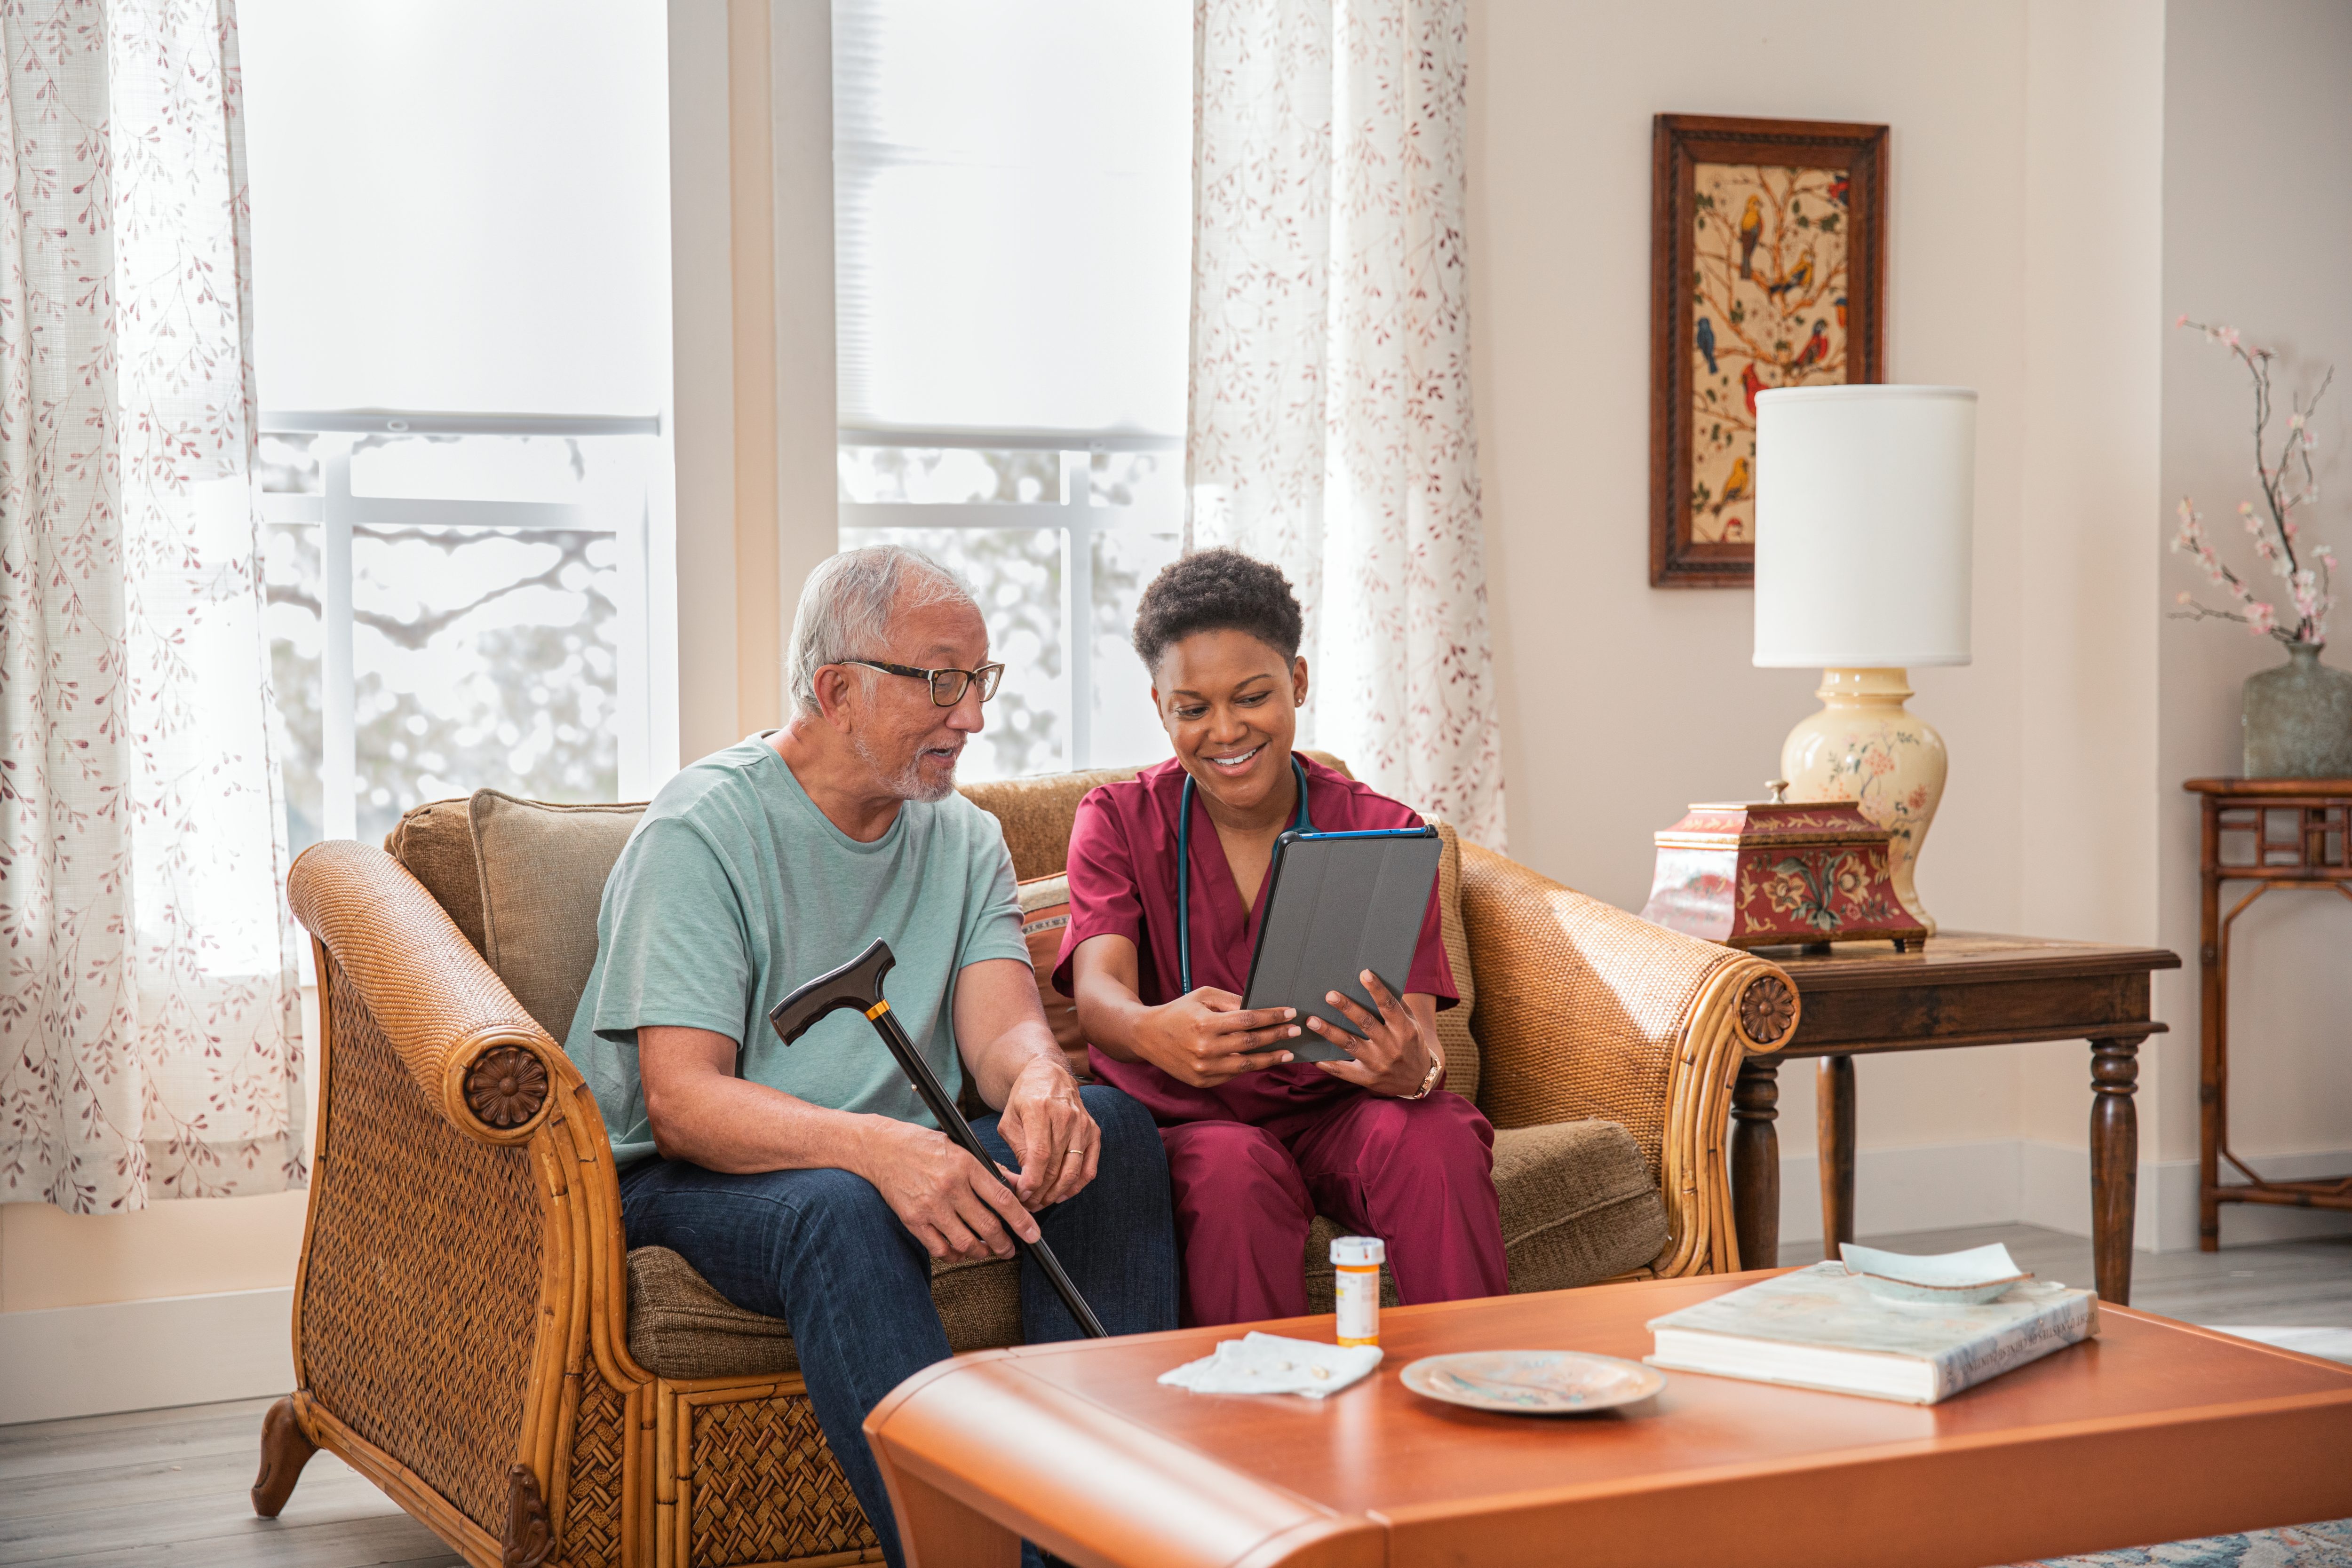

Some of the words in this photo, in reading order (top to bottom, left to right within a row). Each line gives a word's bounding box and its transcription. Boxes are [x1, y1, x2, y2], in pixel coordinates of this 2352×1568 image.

[2036, 1318, 2075, 1340] DYNASTIES
[1999, 1338, 2027, 1359] CHINESE
[1964, 1351, 1997, 1372] PAINTING
